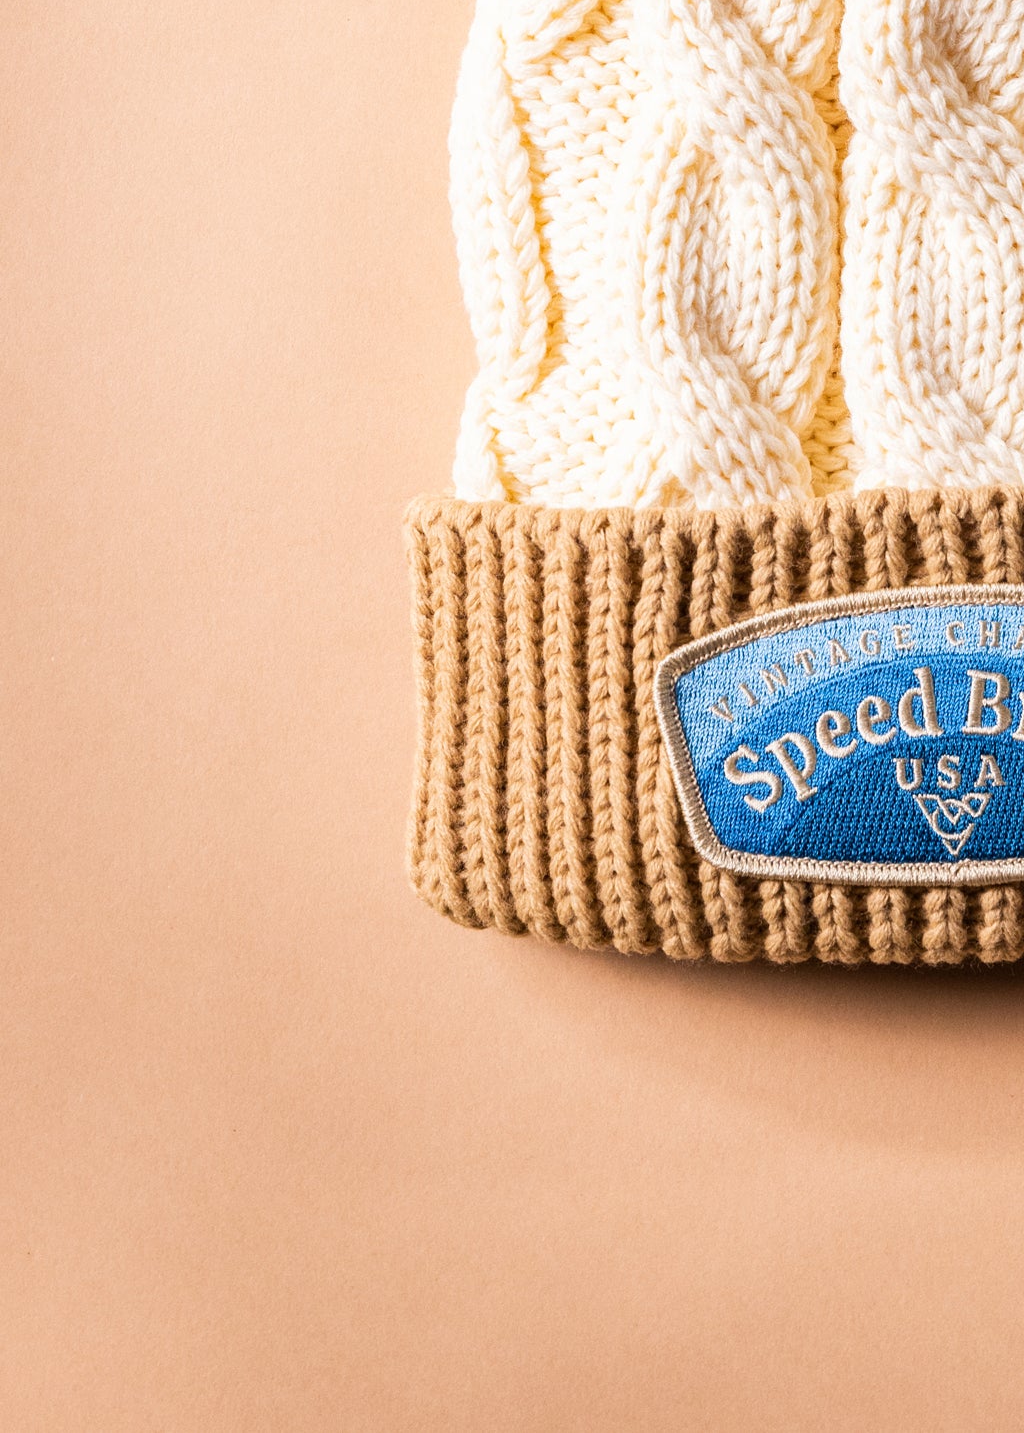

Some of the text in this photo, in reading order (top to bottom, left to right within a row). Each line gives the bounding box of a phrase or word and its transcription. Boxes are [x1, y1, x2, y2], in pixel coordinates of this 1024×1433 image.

[708, 624, 915, 723] VINTAGE
[723, 666, 944, 814] Speed
[892, 753, 1006, 791] USA
